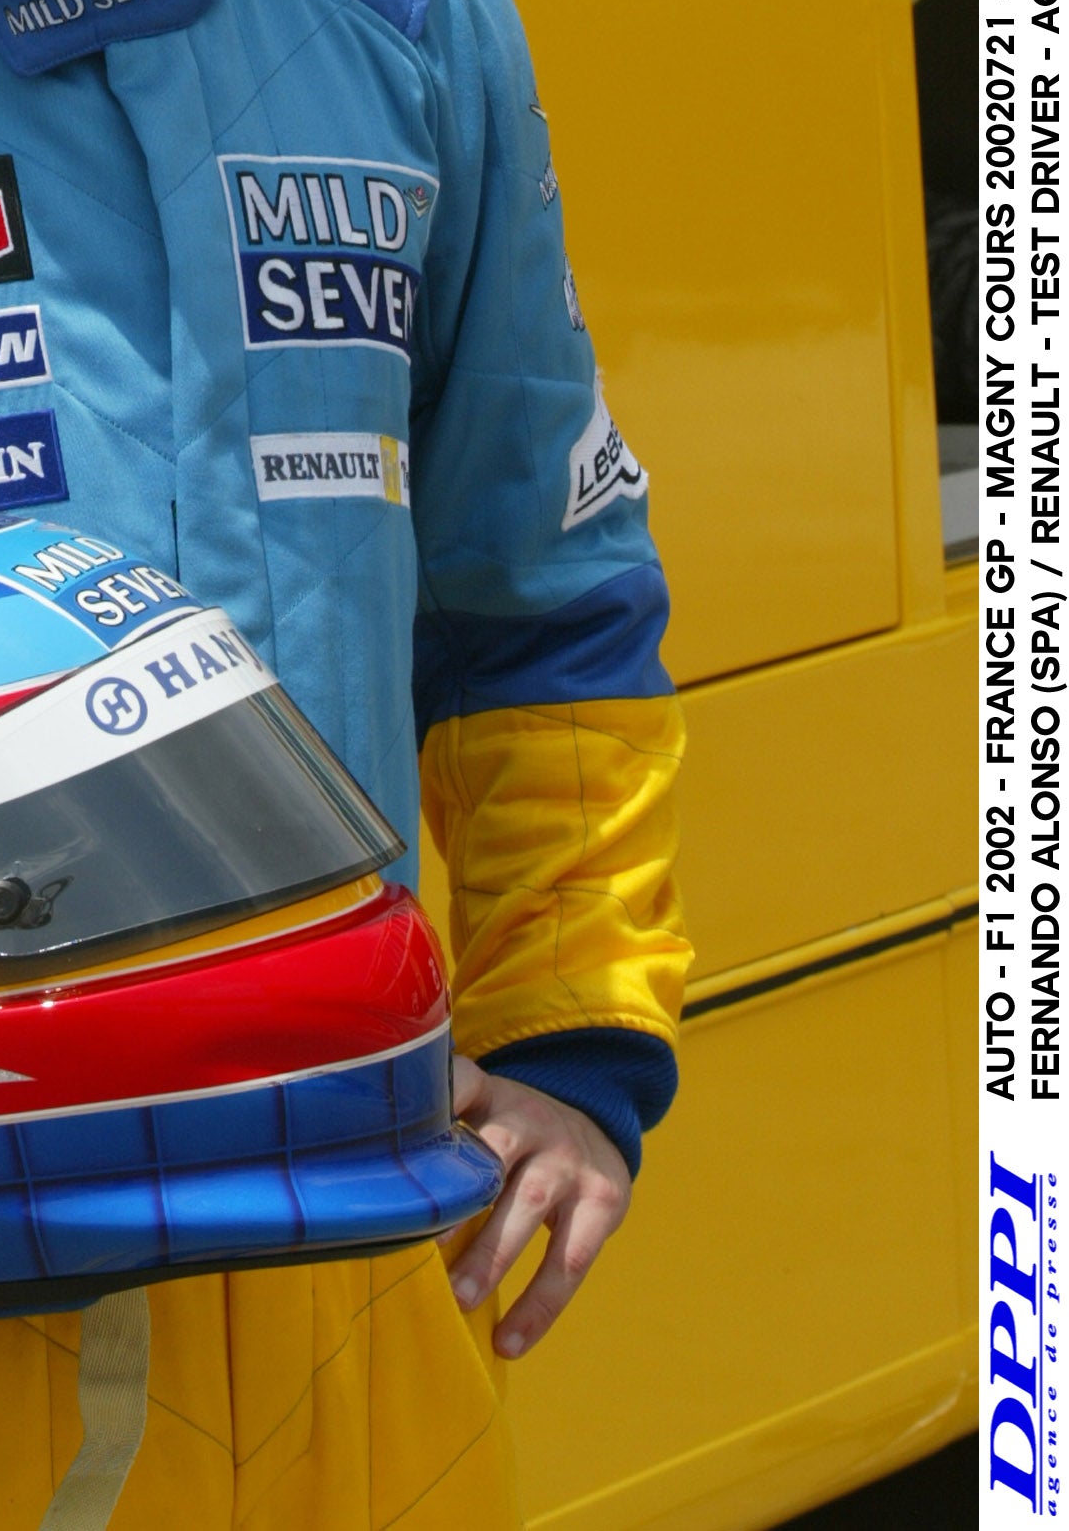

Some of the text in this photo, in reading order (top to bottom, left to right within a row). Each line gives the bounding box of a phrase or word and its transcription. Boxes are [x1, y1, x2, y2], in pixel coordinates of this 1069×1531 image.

[237, 172, 407, 252] MILD
[261, 453, 379, 482] RENAULT
[11, 536, 127, 592] MILD
